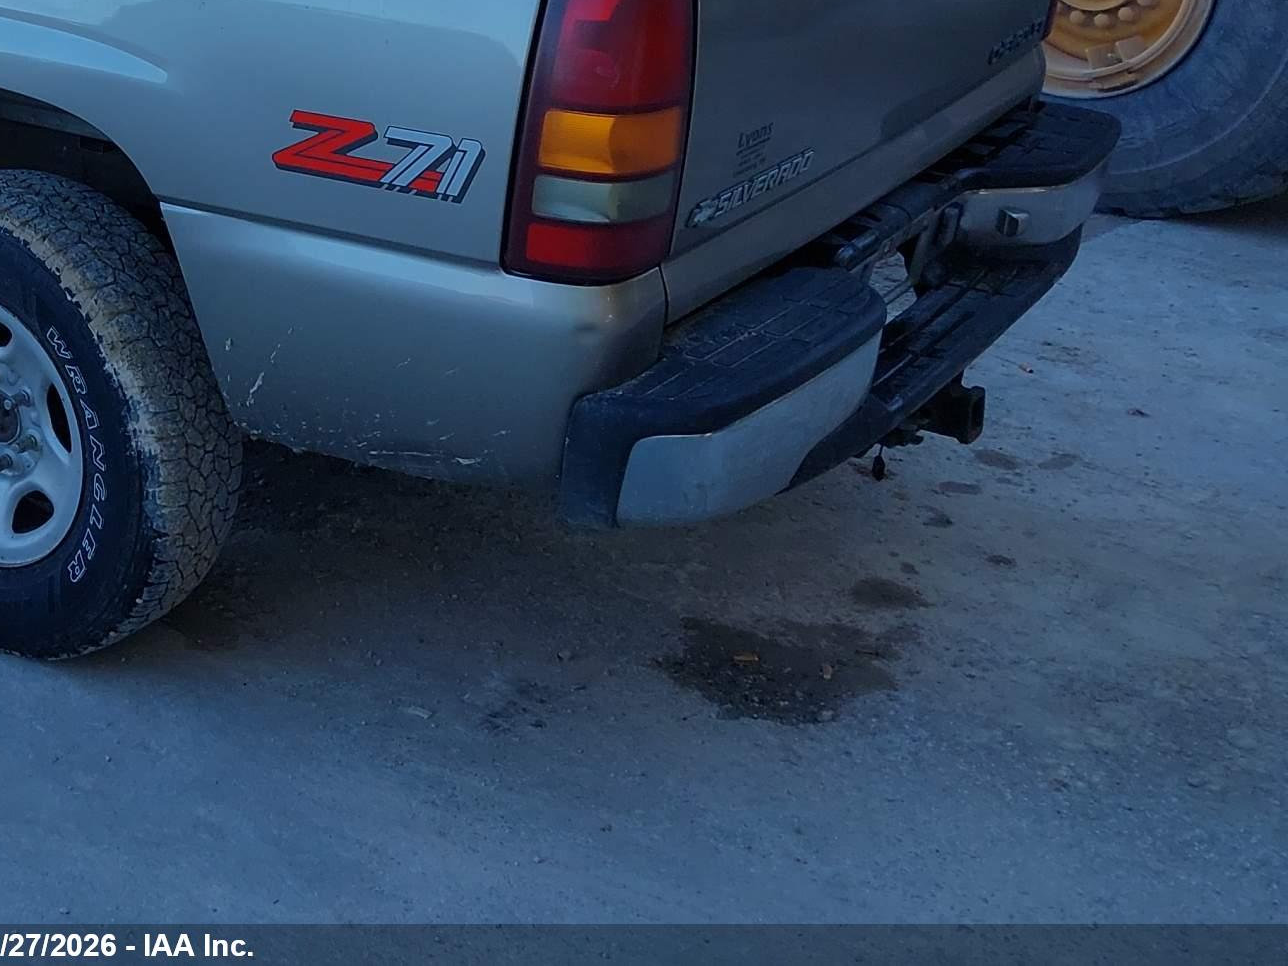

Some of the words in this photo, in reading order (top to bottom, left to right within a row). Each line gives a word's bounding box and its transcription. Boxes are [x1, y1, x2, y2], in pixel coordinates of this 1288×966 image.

[271, 109, 486, 204] Z71
[714, 148, 815, 217] SILVERADO
[46, 325, 107, 583] WRANGLER
